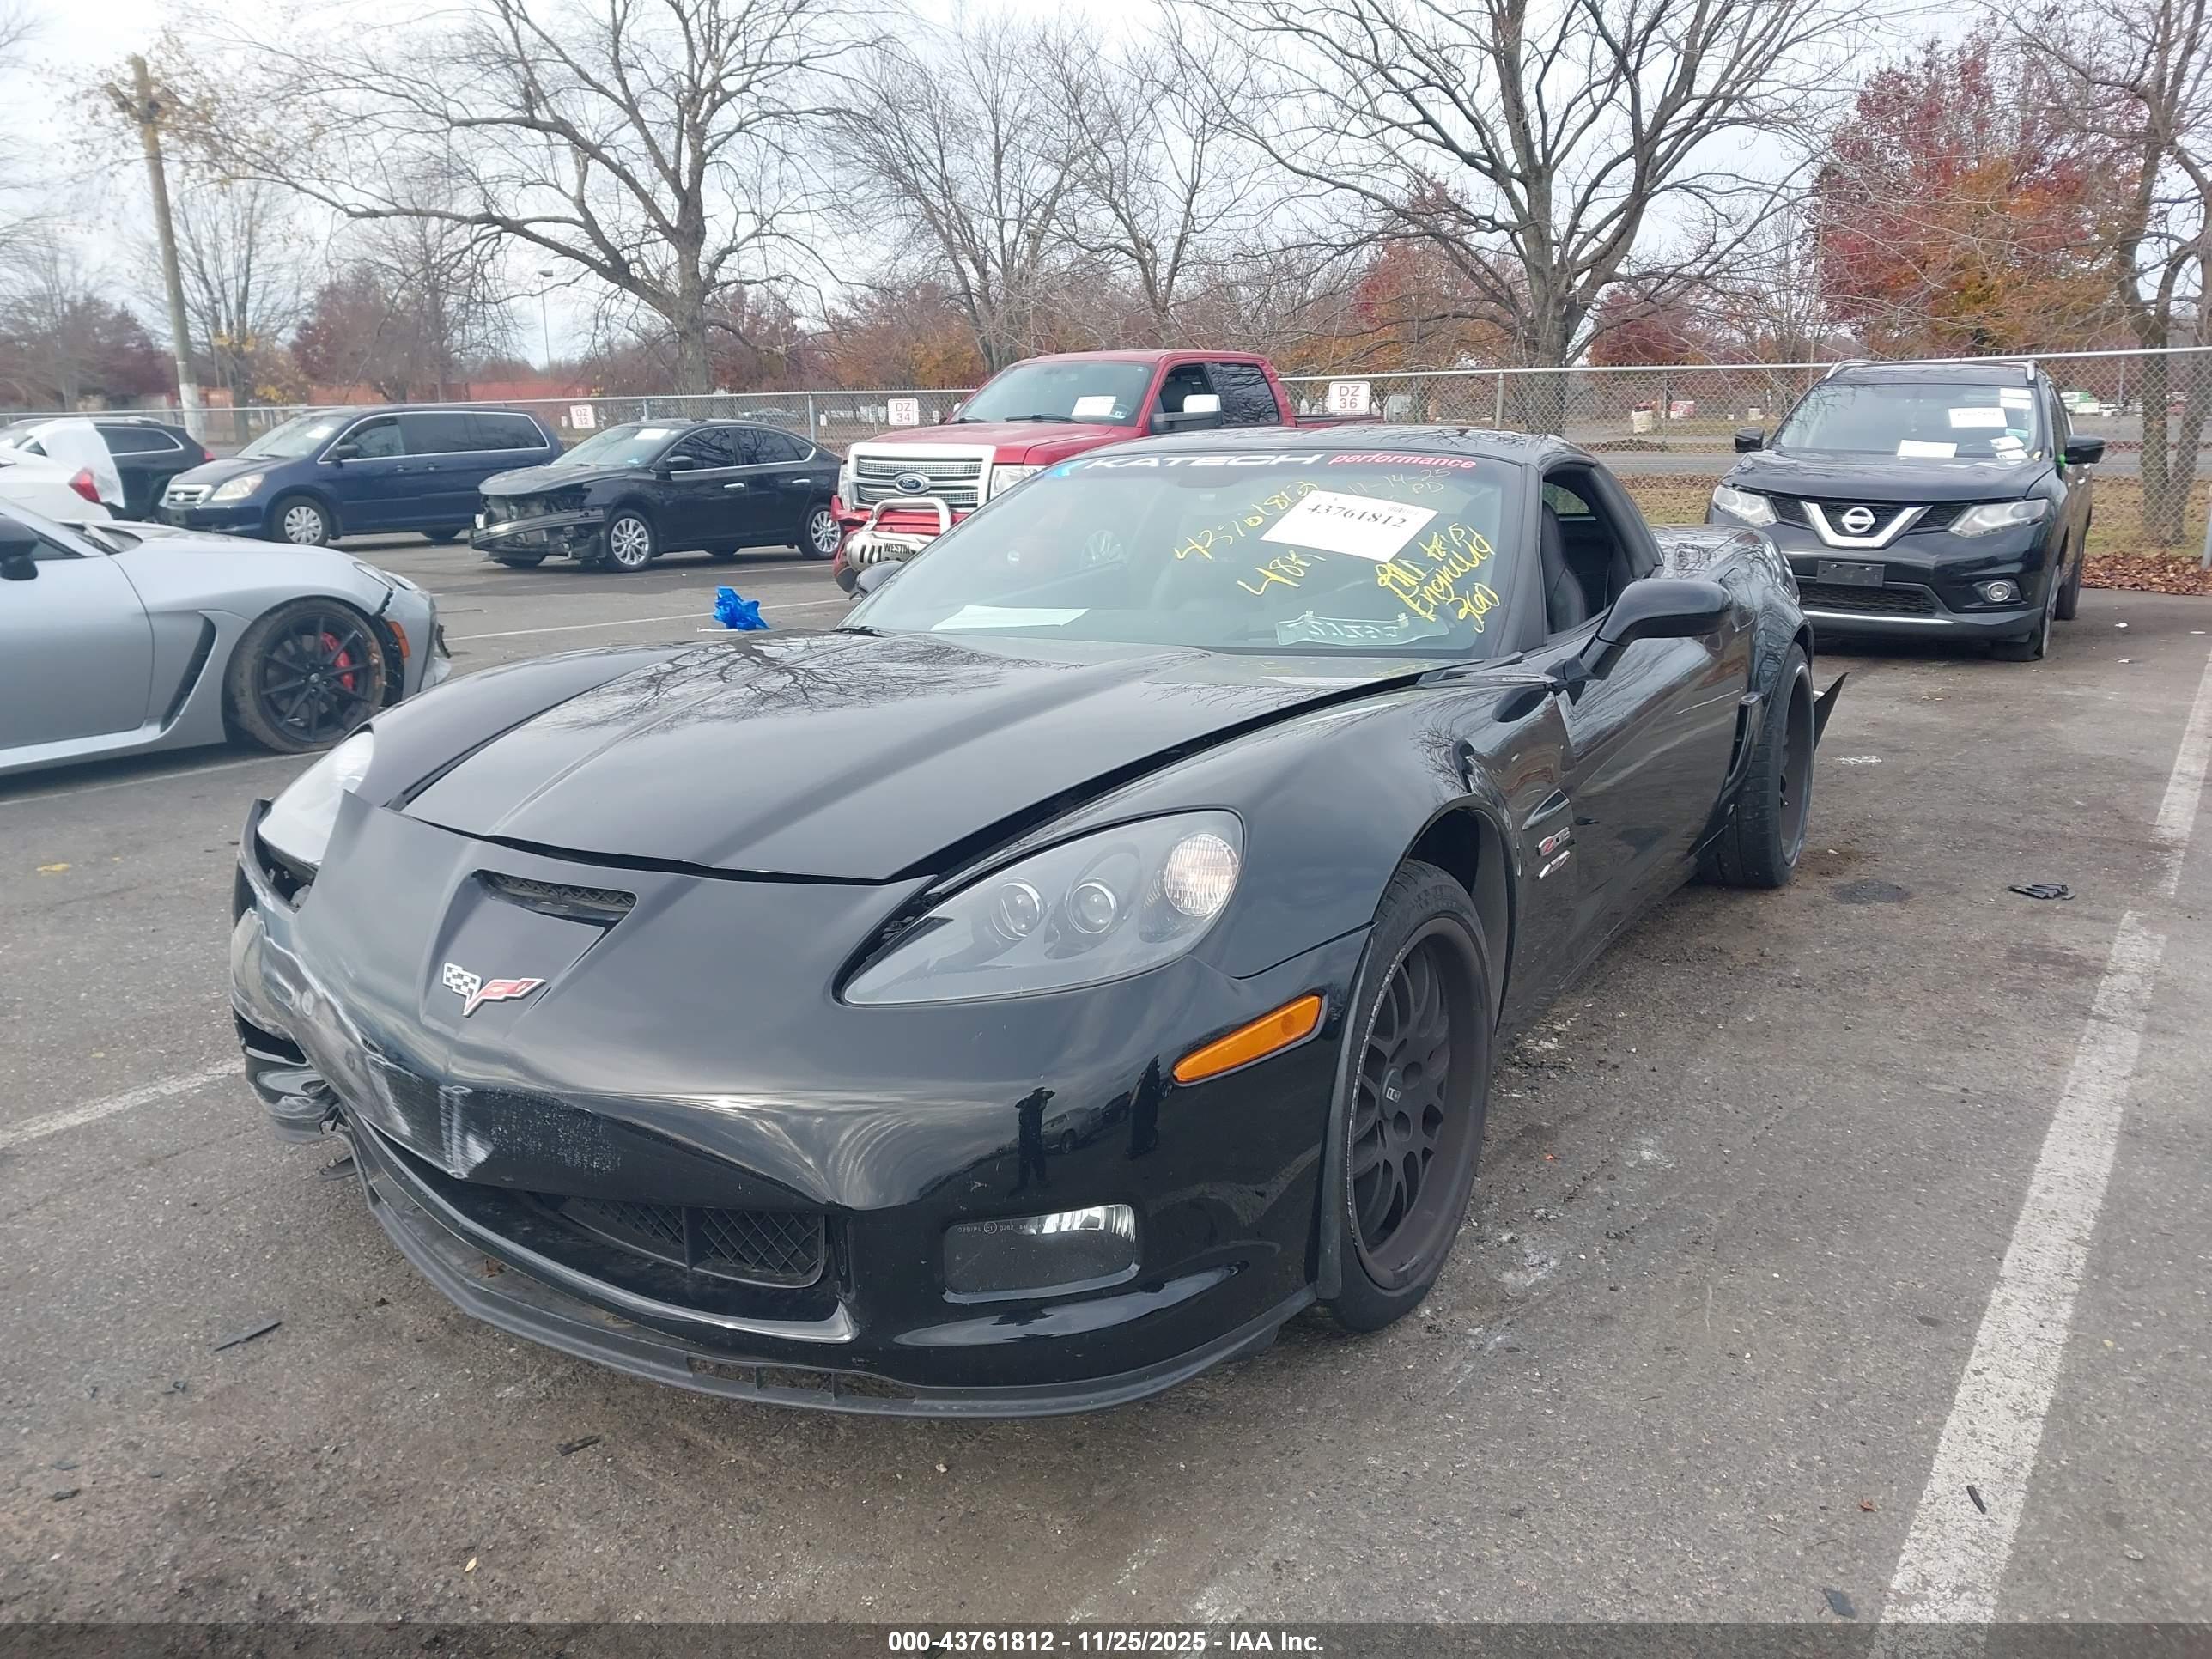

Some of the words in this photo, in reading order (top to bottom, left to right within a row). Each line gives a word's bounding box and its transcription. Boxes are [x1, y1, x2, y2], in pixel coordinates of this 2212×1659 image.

[1339, 386, 1361, 397] DZ
[895, 402, 912, 412] DZ
[1339, 398, 1358, 409] 36
[896, 412, 911, 422] 34
[1085, 453, 1325, 470] KATECH
[1328, 453, 1478, 469] performance
[1308, 504, 1407, 528] 43761812
